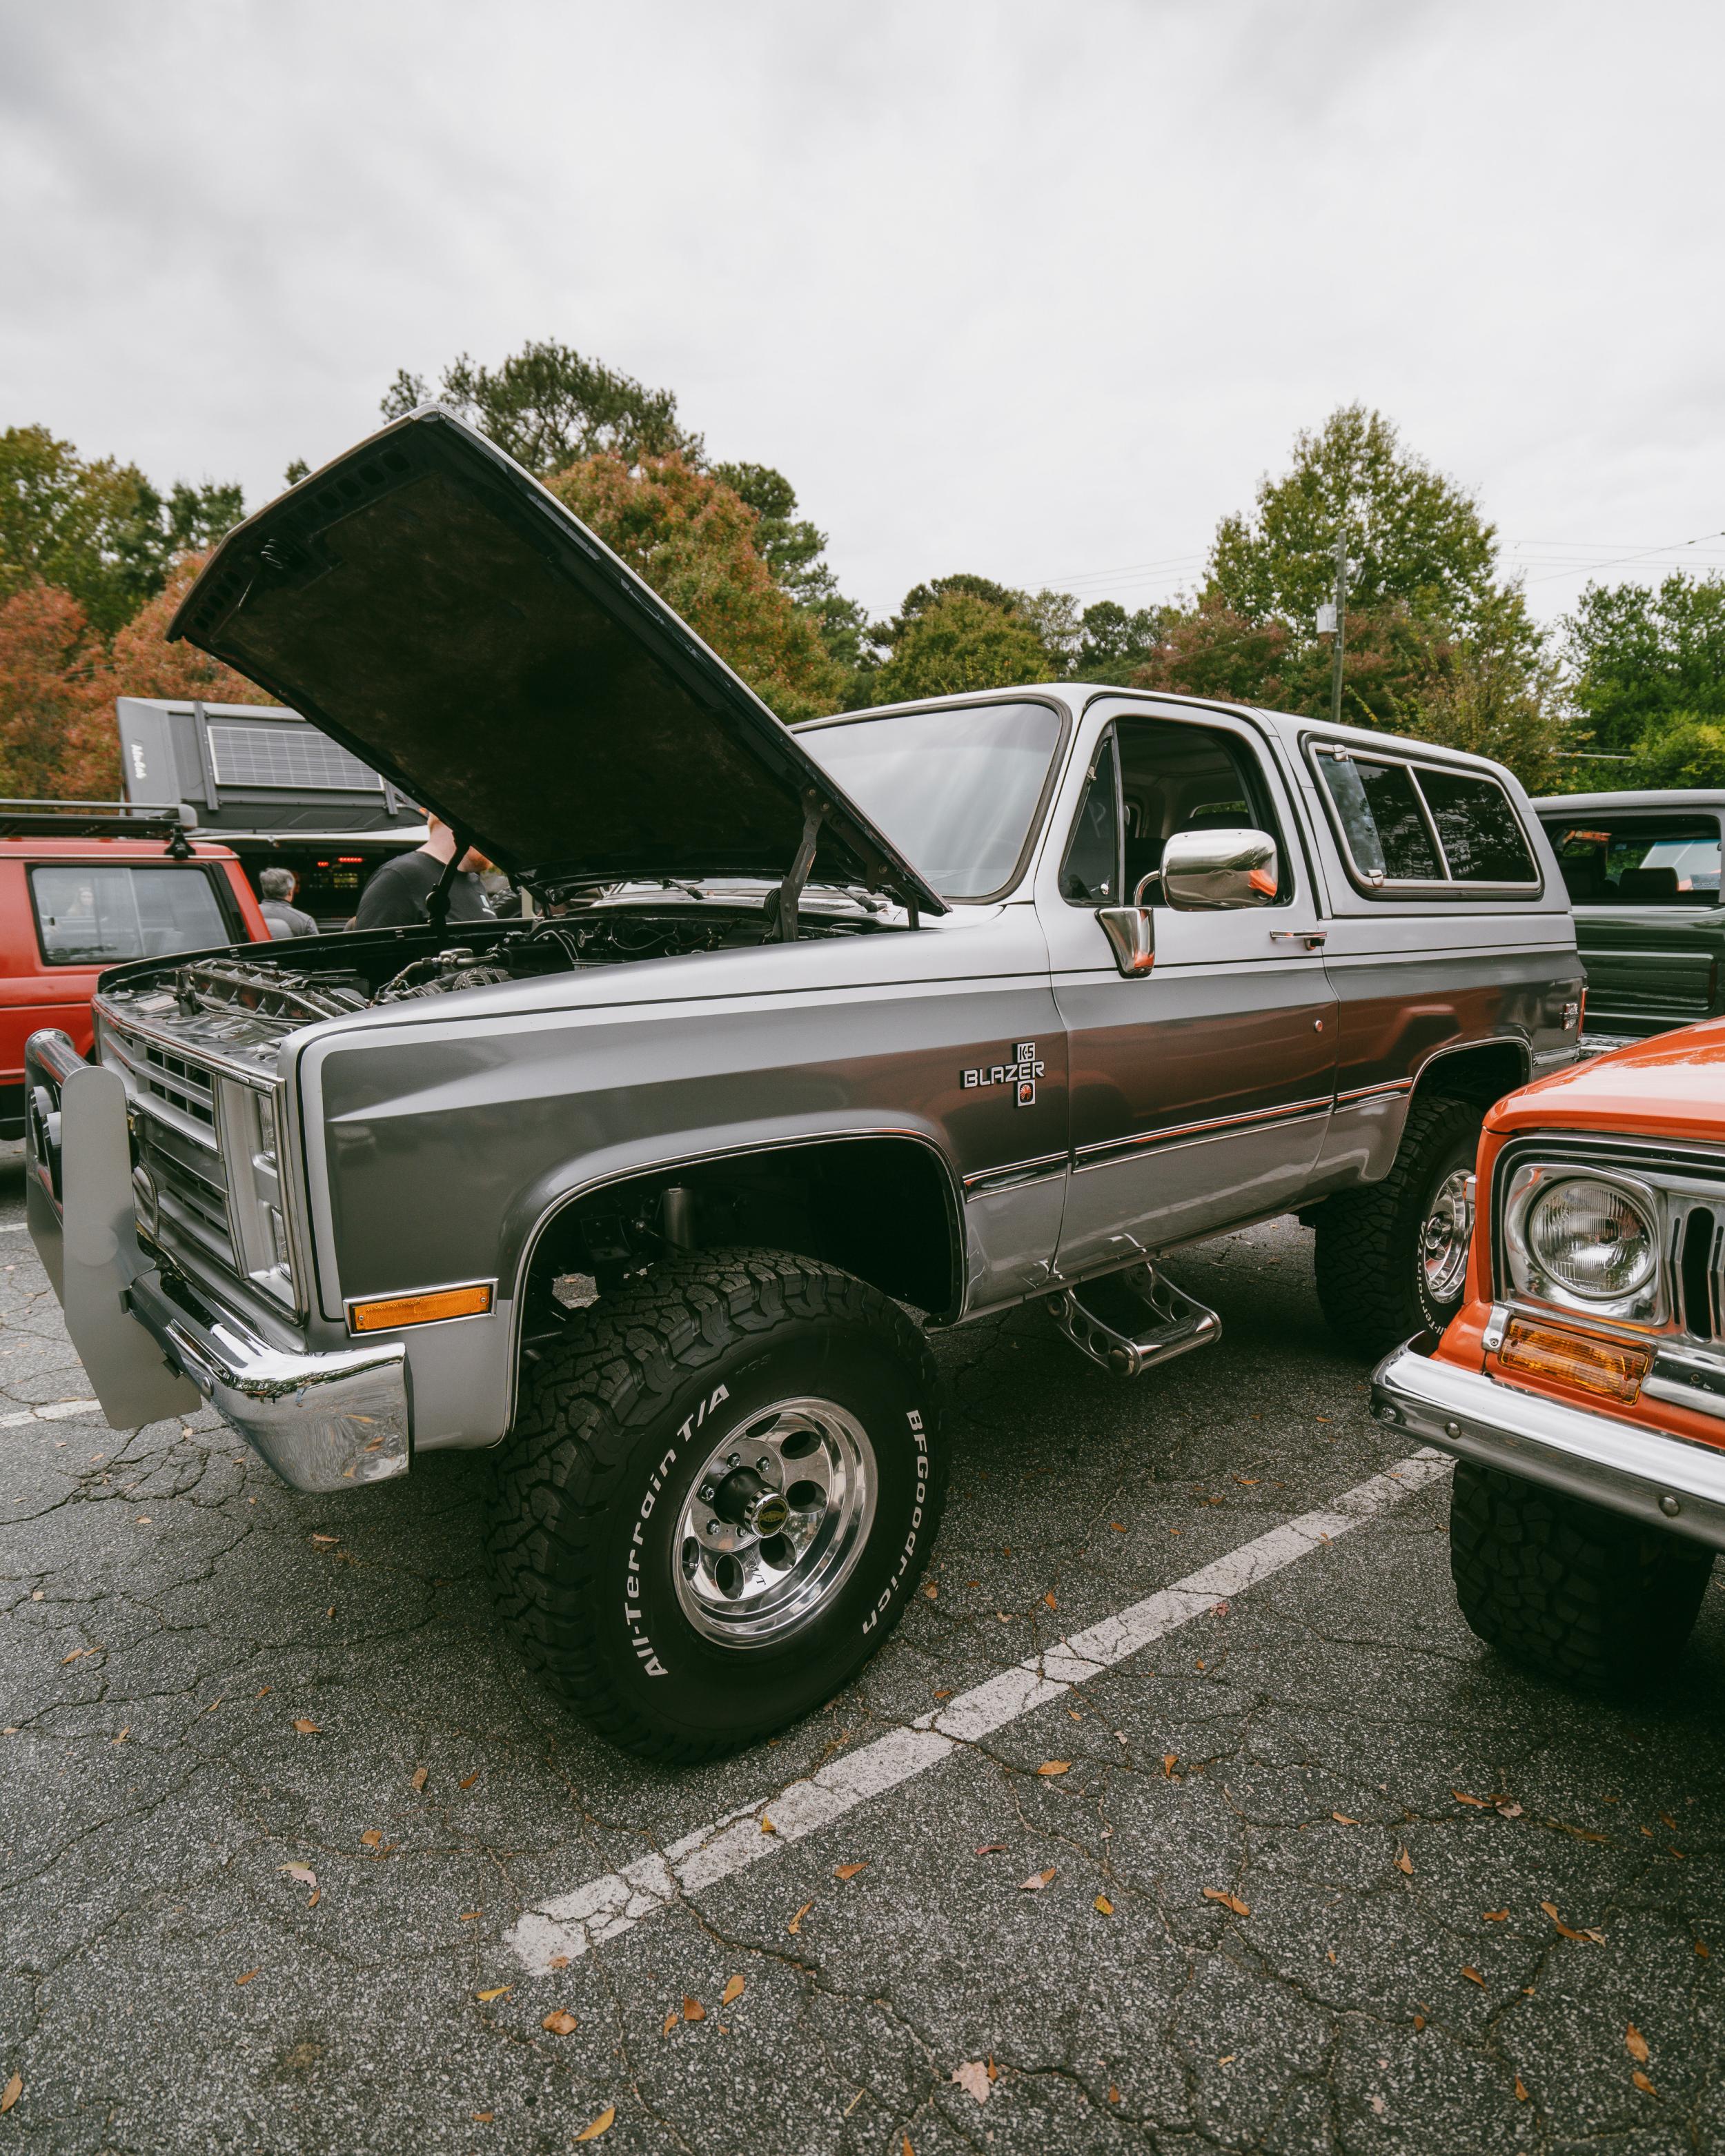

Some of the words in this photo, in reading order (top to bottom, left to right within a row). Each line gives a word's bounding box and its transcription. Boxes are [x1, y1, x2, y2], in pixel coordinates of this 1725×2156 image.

[964, 1061, 1045, 1088] BLAZER
[1418, 1221, 1427, 1256] T/A
[1417, 1261, 1447, 1336] ll-Terrain
[624, 1449, 677, 1677] All-Terrain
[678, 1383, 730, 1442] T/A
[862, 1410, 929, 1634] BFGoodrich
